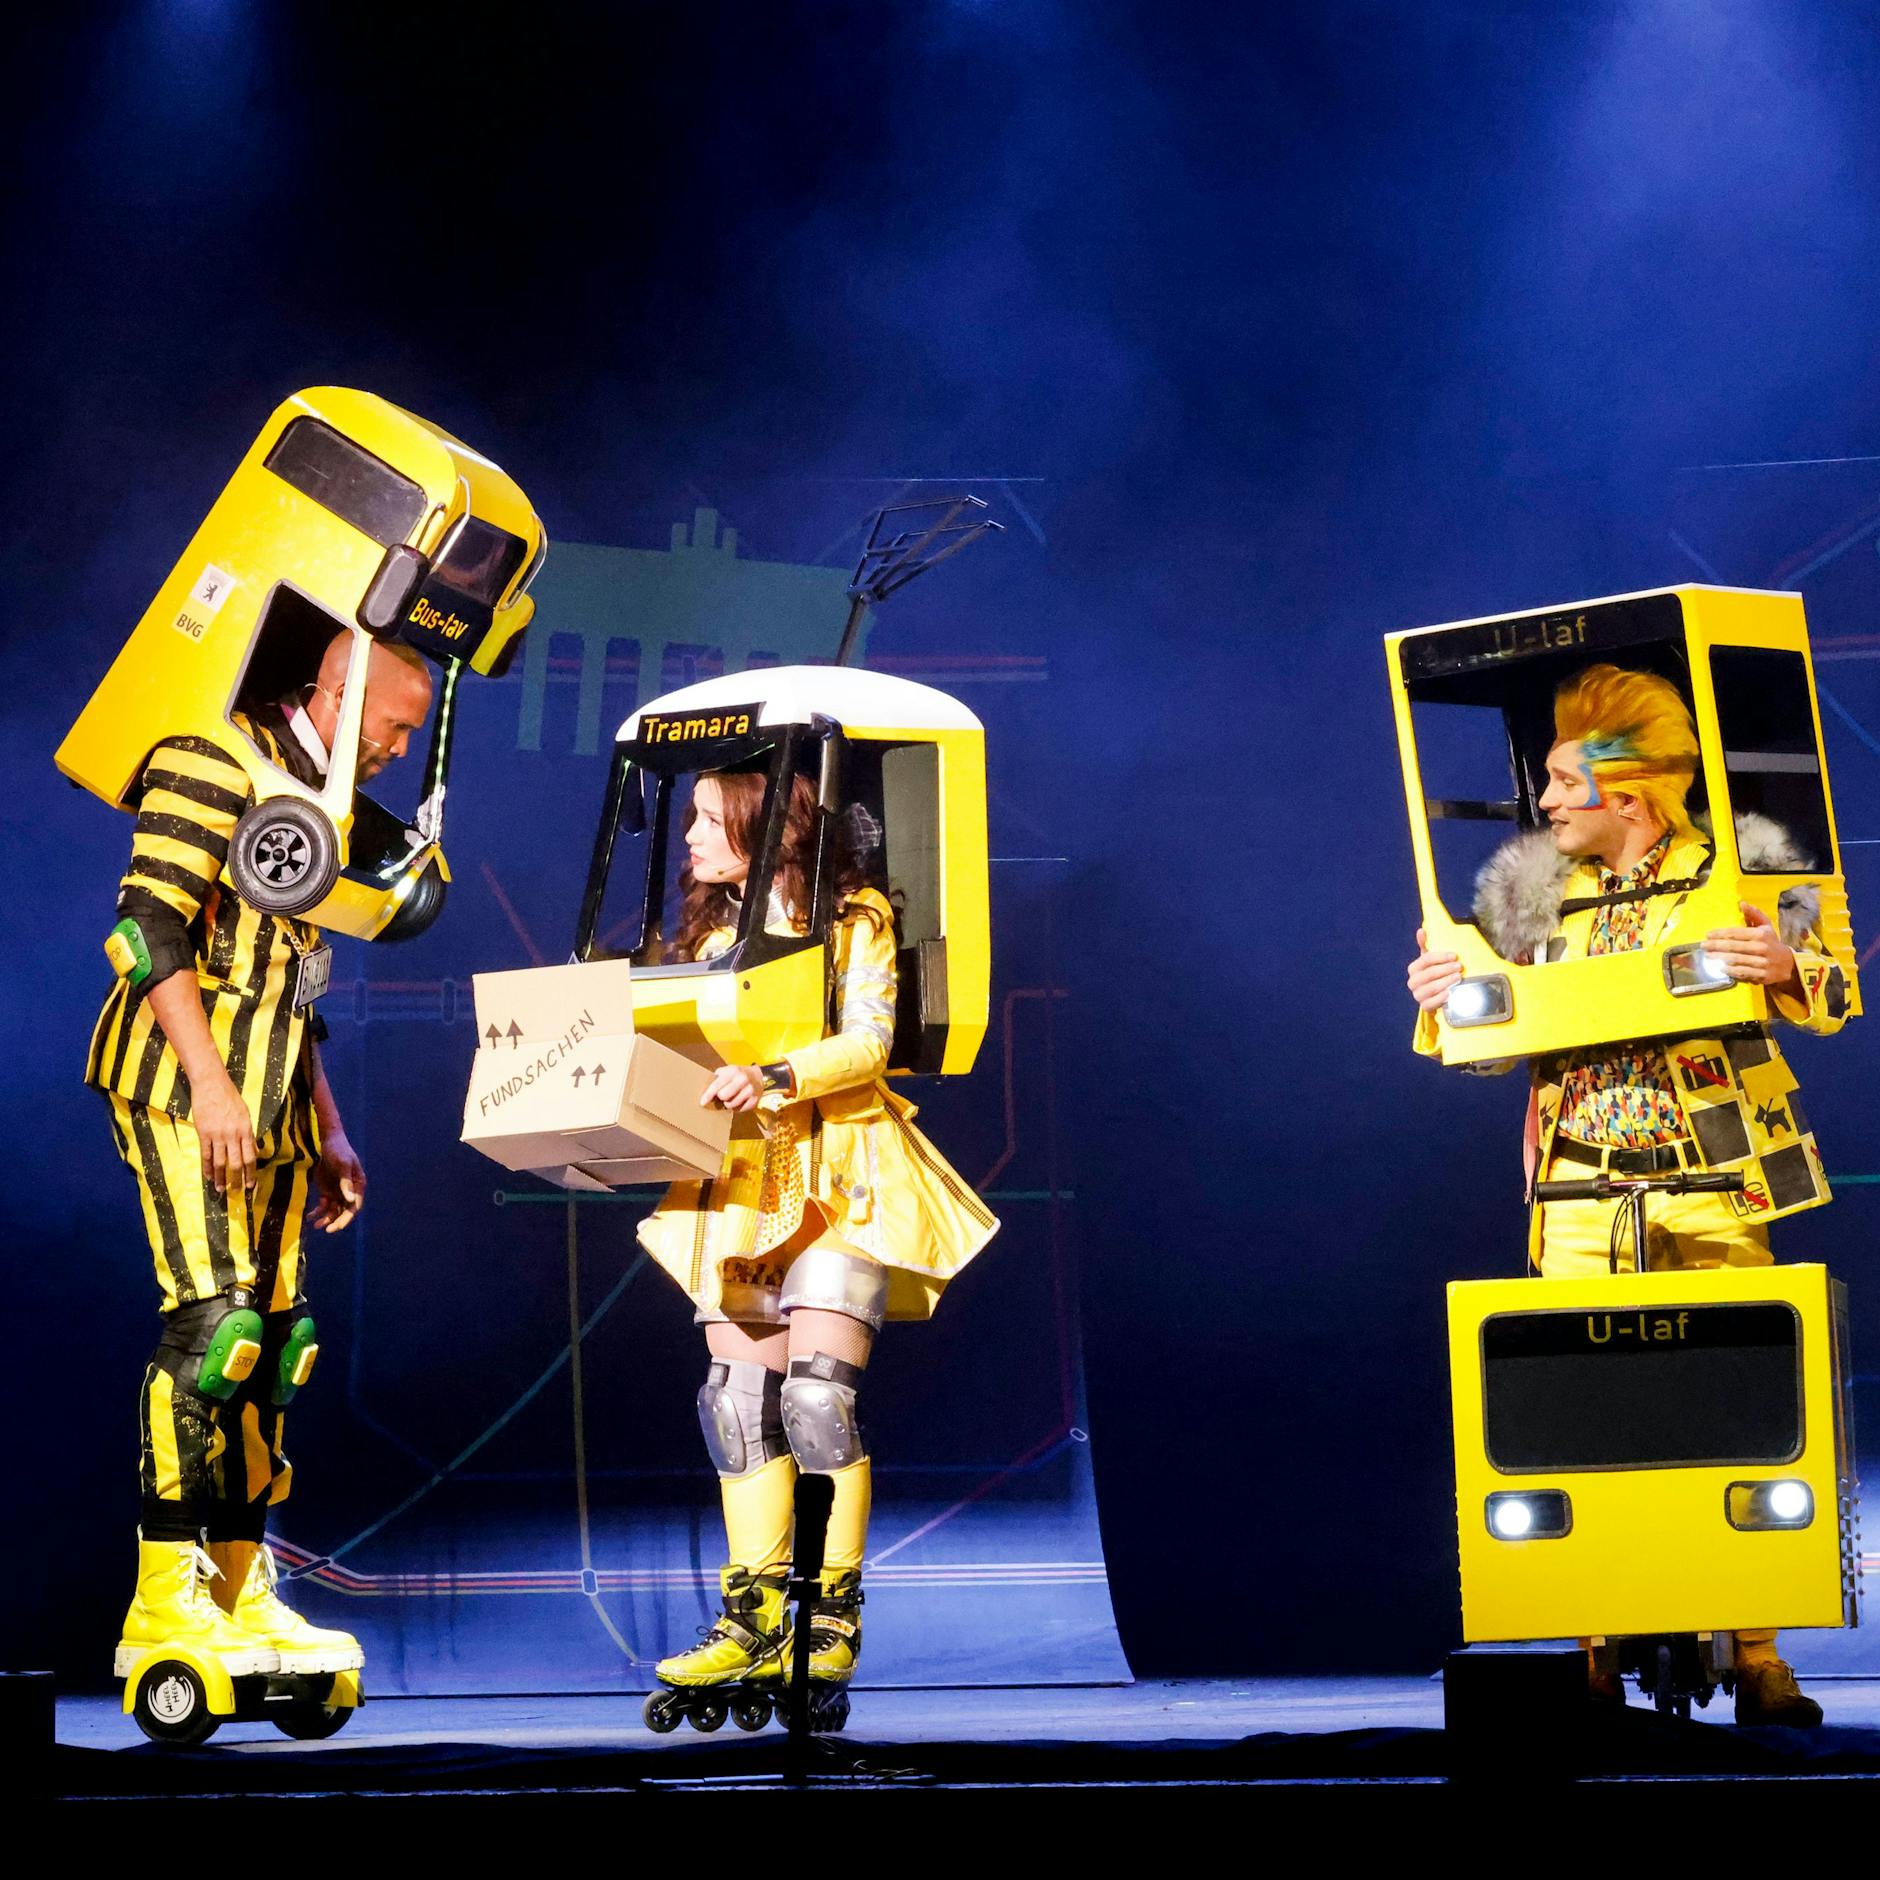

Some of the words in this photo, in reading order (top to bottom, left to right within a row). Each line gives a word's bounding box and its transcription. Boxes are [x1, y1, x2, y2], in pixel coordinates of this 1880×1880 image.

[176, 613, 205, 638] BVG
[408, 597, 469, 641] Bus-tav
[644, 714, 750, 744] Tramara
[479, 1008, 595, 1117] FUNDSACHEN
[1587, 1311, 1690, 1344] U-laf
